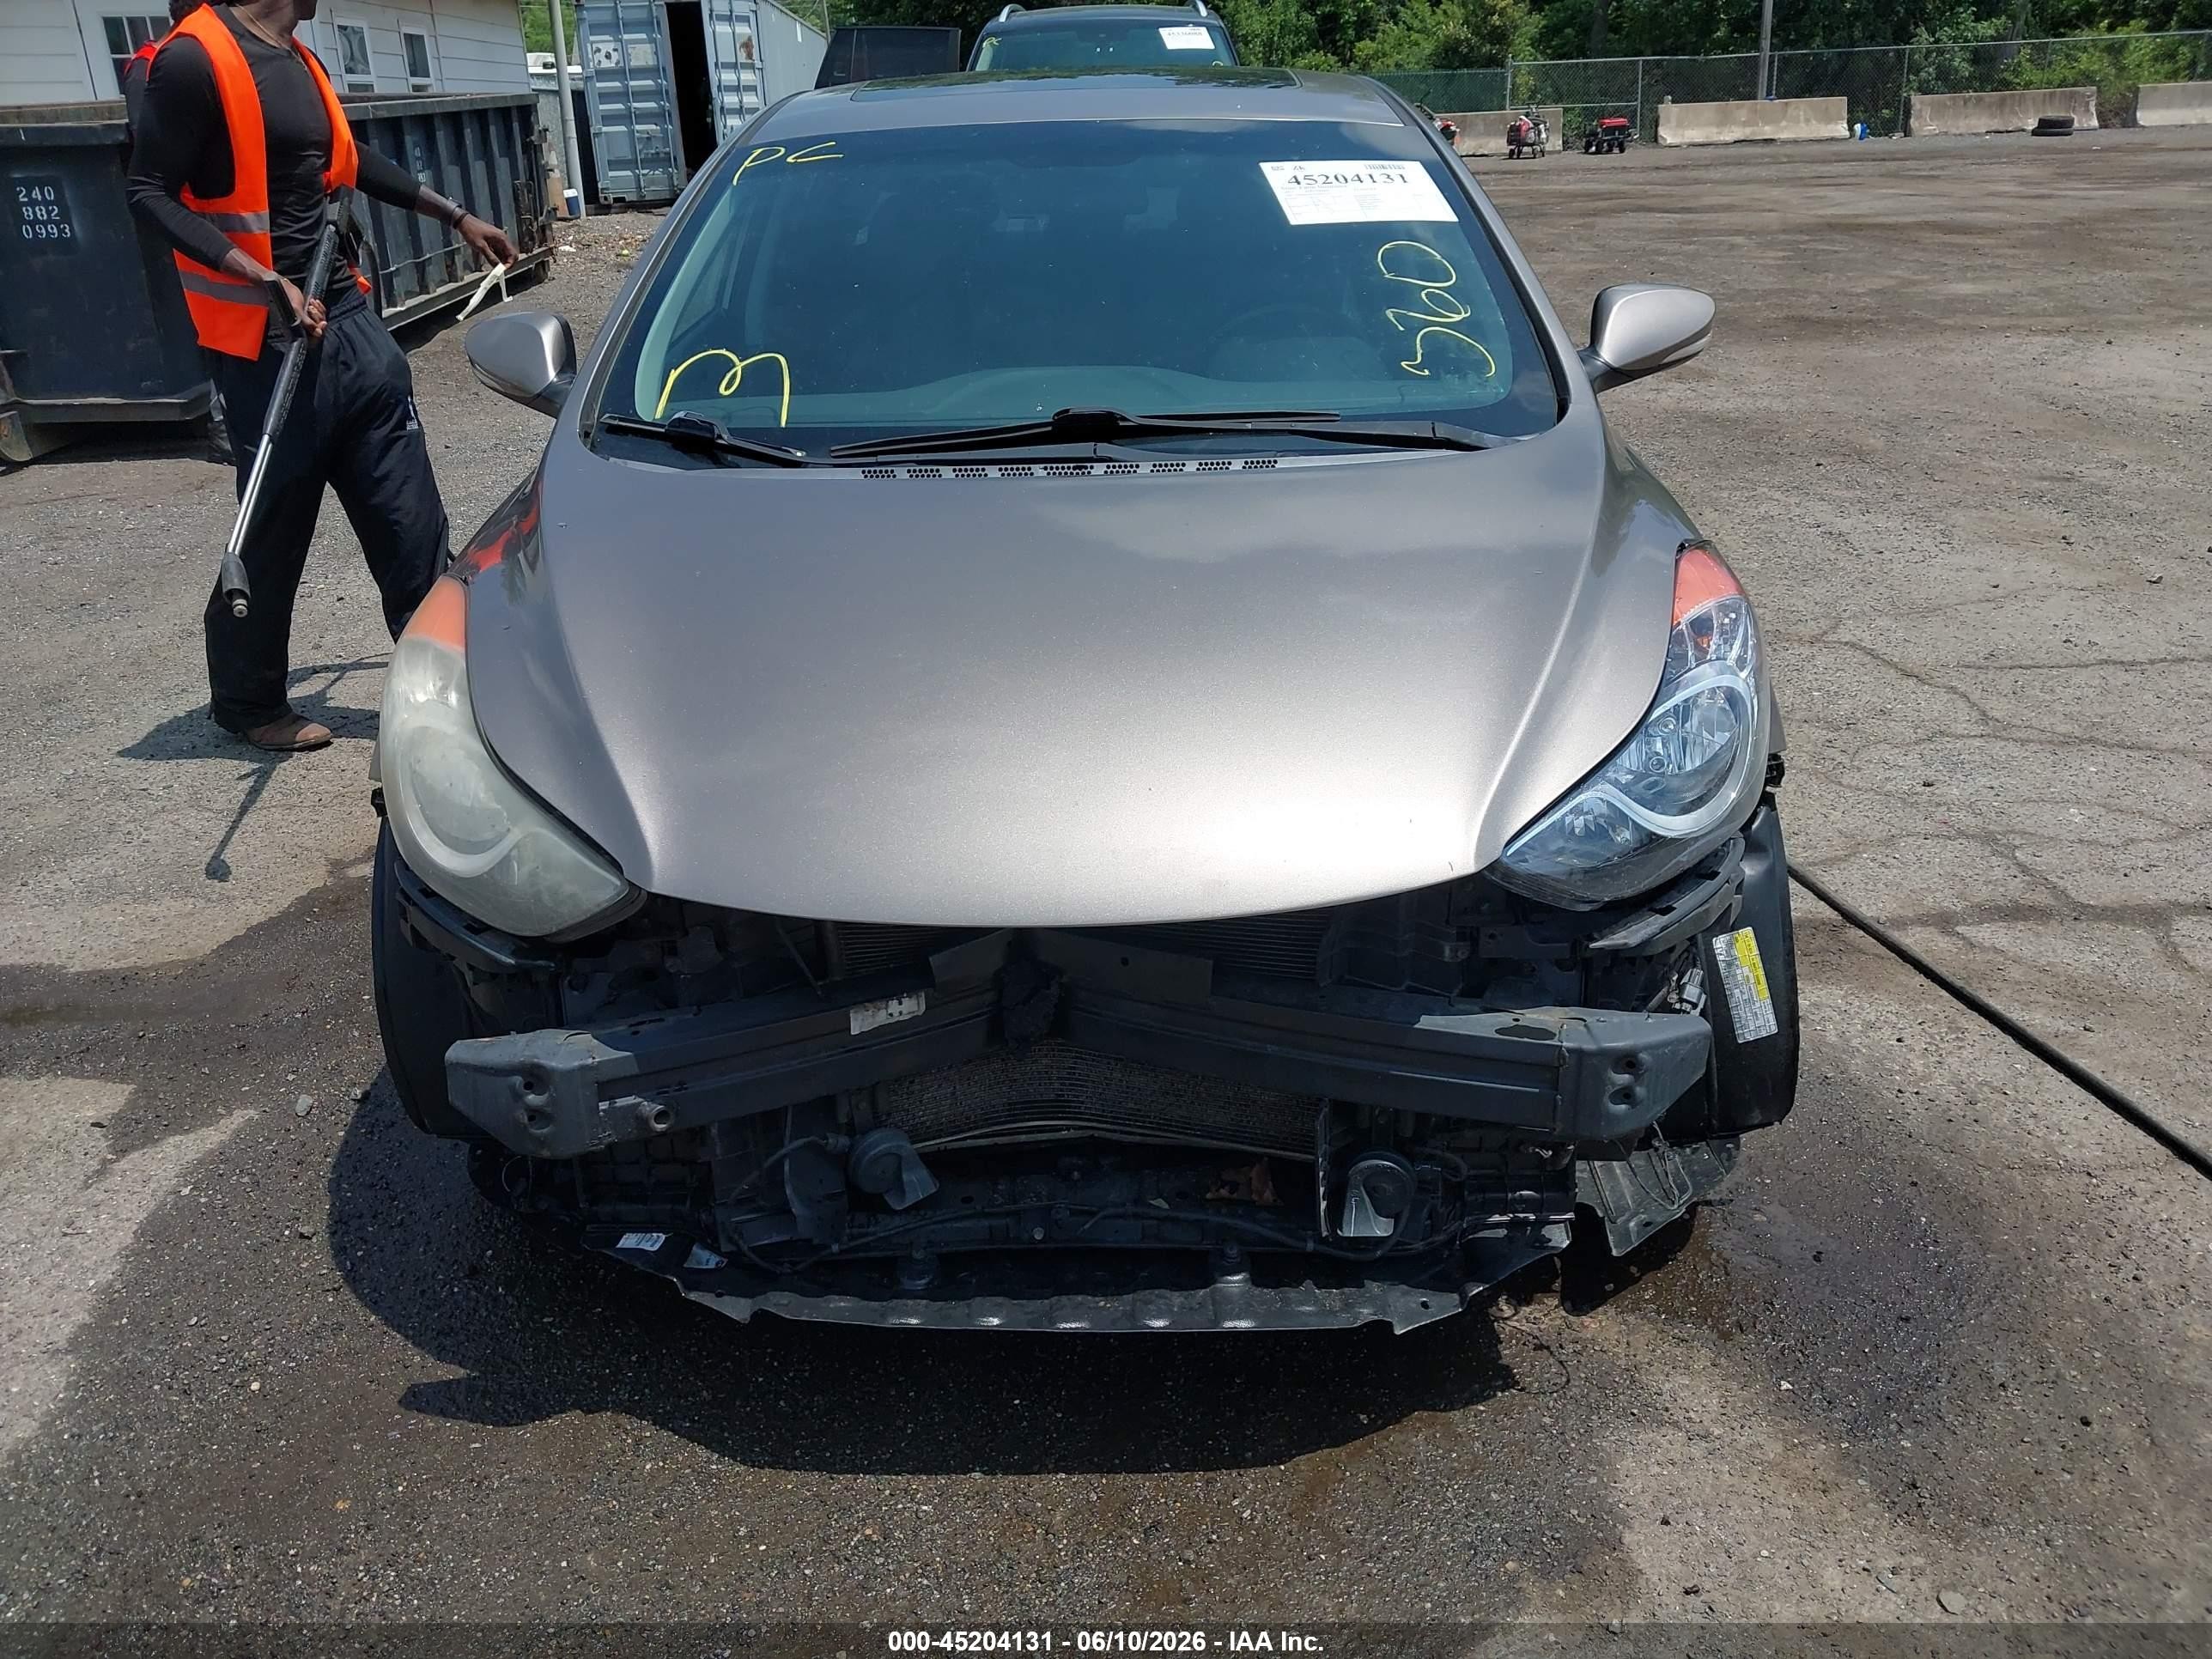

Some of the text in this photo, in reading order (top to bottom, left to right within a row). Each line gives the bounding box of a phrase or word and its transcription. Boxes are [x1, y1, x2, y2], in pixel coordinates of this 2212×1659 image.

[1287, 173, 1409, 185] 45204131
[16, 185, 55, 202] 240
[22, 205, 61, 221] 882
[22, 223, 71, 239] 0993
